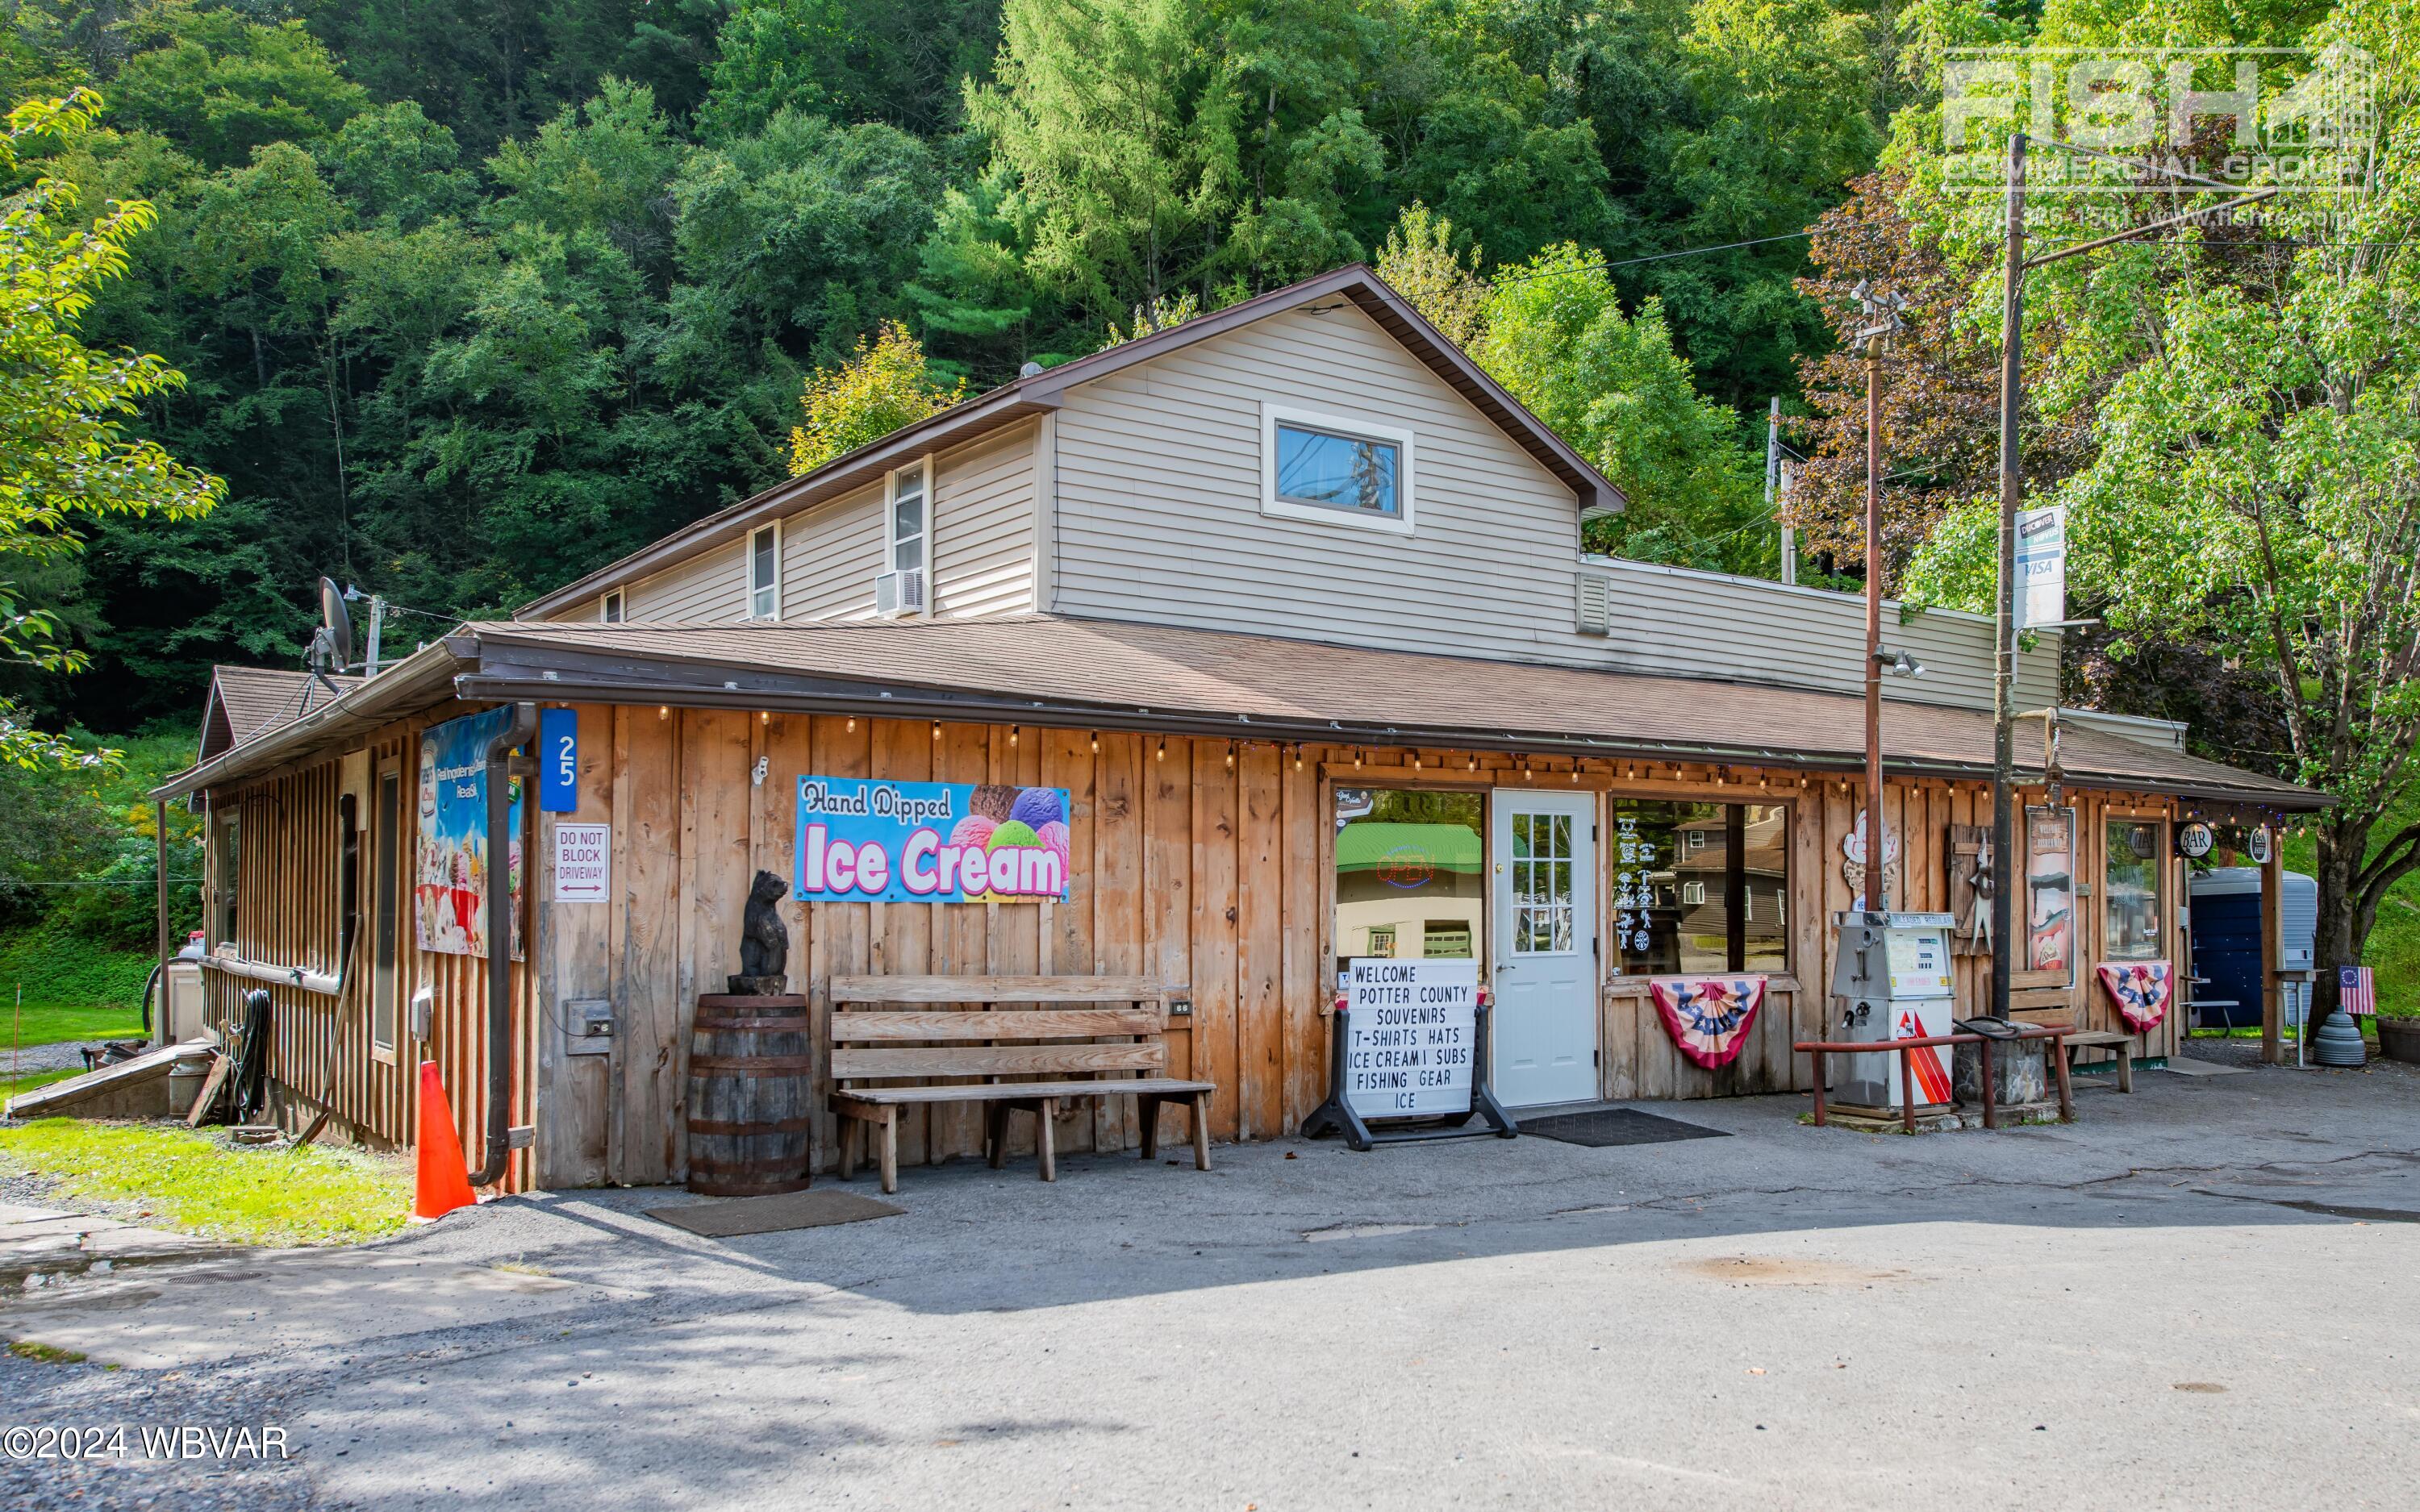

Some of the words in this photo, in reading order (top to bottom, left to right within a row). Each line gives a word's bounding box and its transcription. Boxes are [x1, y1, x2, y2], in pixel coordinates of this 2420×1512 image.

[2025, 560, 2052, 577] VISA
[803, 782, 869, 814] Hand
[873, 786, 951, 825] Dipped
[561, 832, 576, 845] DO
[580, 832, 603, 845] NOT
[2183, 831, 2209, 848] BAR
[562, 849, 601, 862] BLOCK
[804, 823, 889, 894] Ice
[900, 827, 1063, 896] Cream
[559, 866, 603, 880] DRIVEWAY
[1377, 853, 1435, 881] OPEN
[1891, 915, 1921, 924] UNLEADED
[1924, 915, 1952, 925] REGULAR
[1355, 966, 1416, 983] WELCOME
[1359, 987, 1409, 1004] POTTER
[1420, 986, 1468, 1004] COUNTY
[1377, 1007, 1446, 1026] SOUVENIRS
[1355, 1028, 1417, 1048] T-SHIRTS
[1429, 1027, 1459, 1044] HATS
[1349, 1052, 1370, 1069] ICE
[1437, 1048, 1467, 1065] SUBS
[1357, 1072, 1408, 1089] FISHING
[1419, 1069, 1451, 1086] GEAR
[1396, 1093, 1415, 1109] ICE
